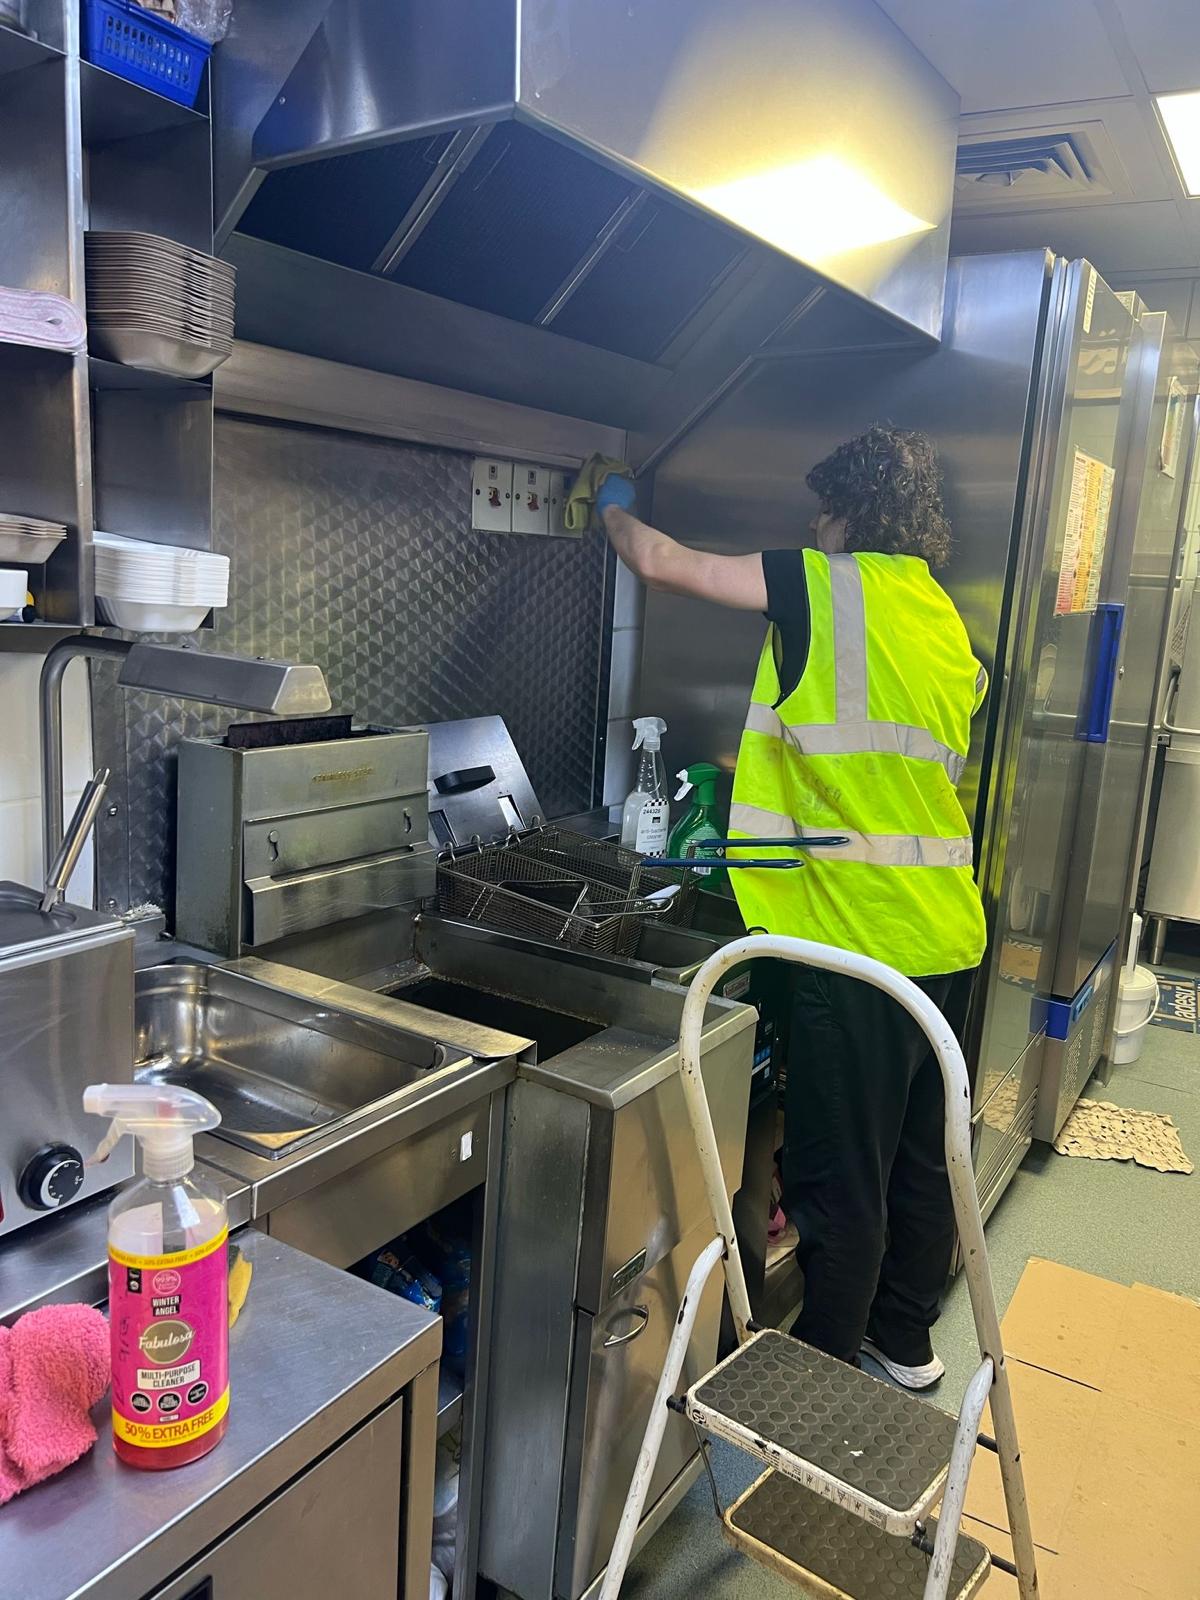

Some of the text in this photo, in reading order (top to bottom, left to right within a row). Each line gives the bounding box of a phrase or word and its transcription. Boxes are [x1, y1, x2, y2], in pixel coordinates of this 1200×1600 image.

[156, 1257, 174, 1265] EXTRA
[174, 1254, 188, 1264] FREE
[152, 1296, 180, 1307] WINTER
[155, 1306, 178, 1316] ANGEL
[138, 1330, 196, 1350] Fabulosa
[141, 1363, 196, 1380] MULTI-PURPOSE
[152, 1376, 185, 1388] CLEANER
[152, 1422, 190, 1440] EXTRA
[191, 1408, 215, 1431] FREE
